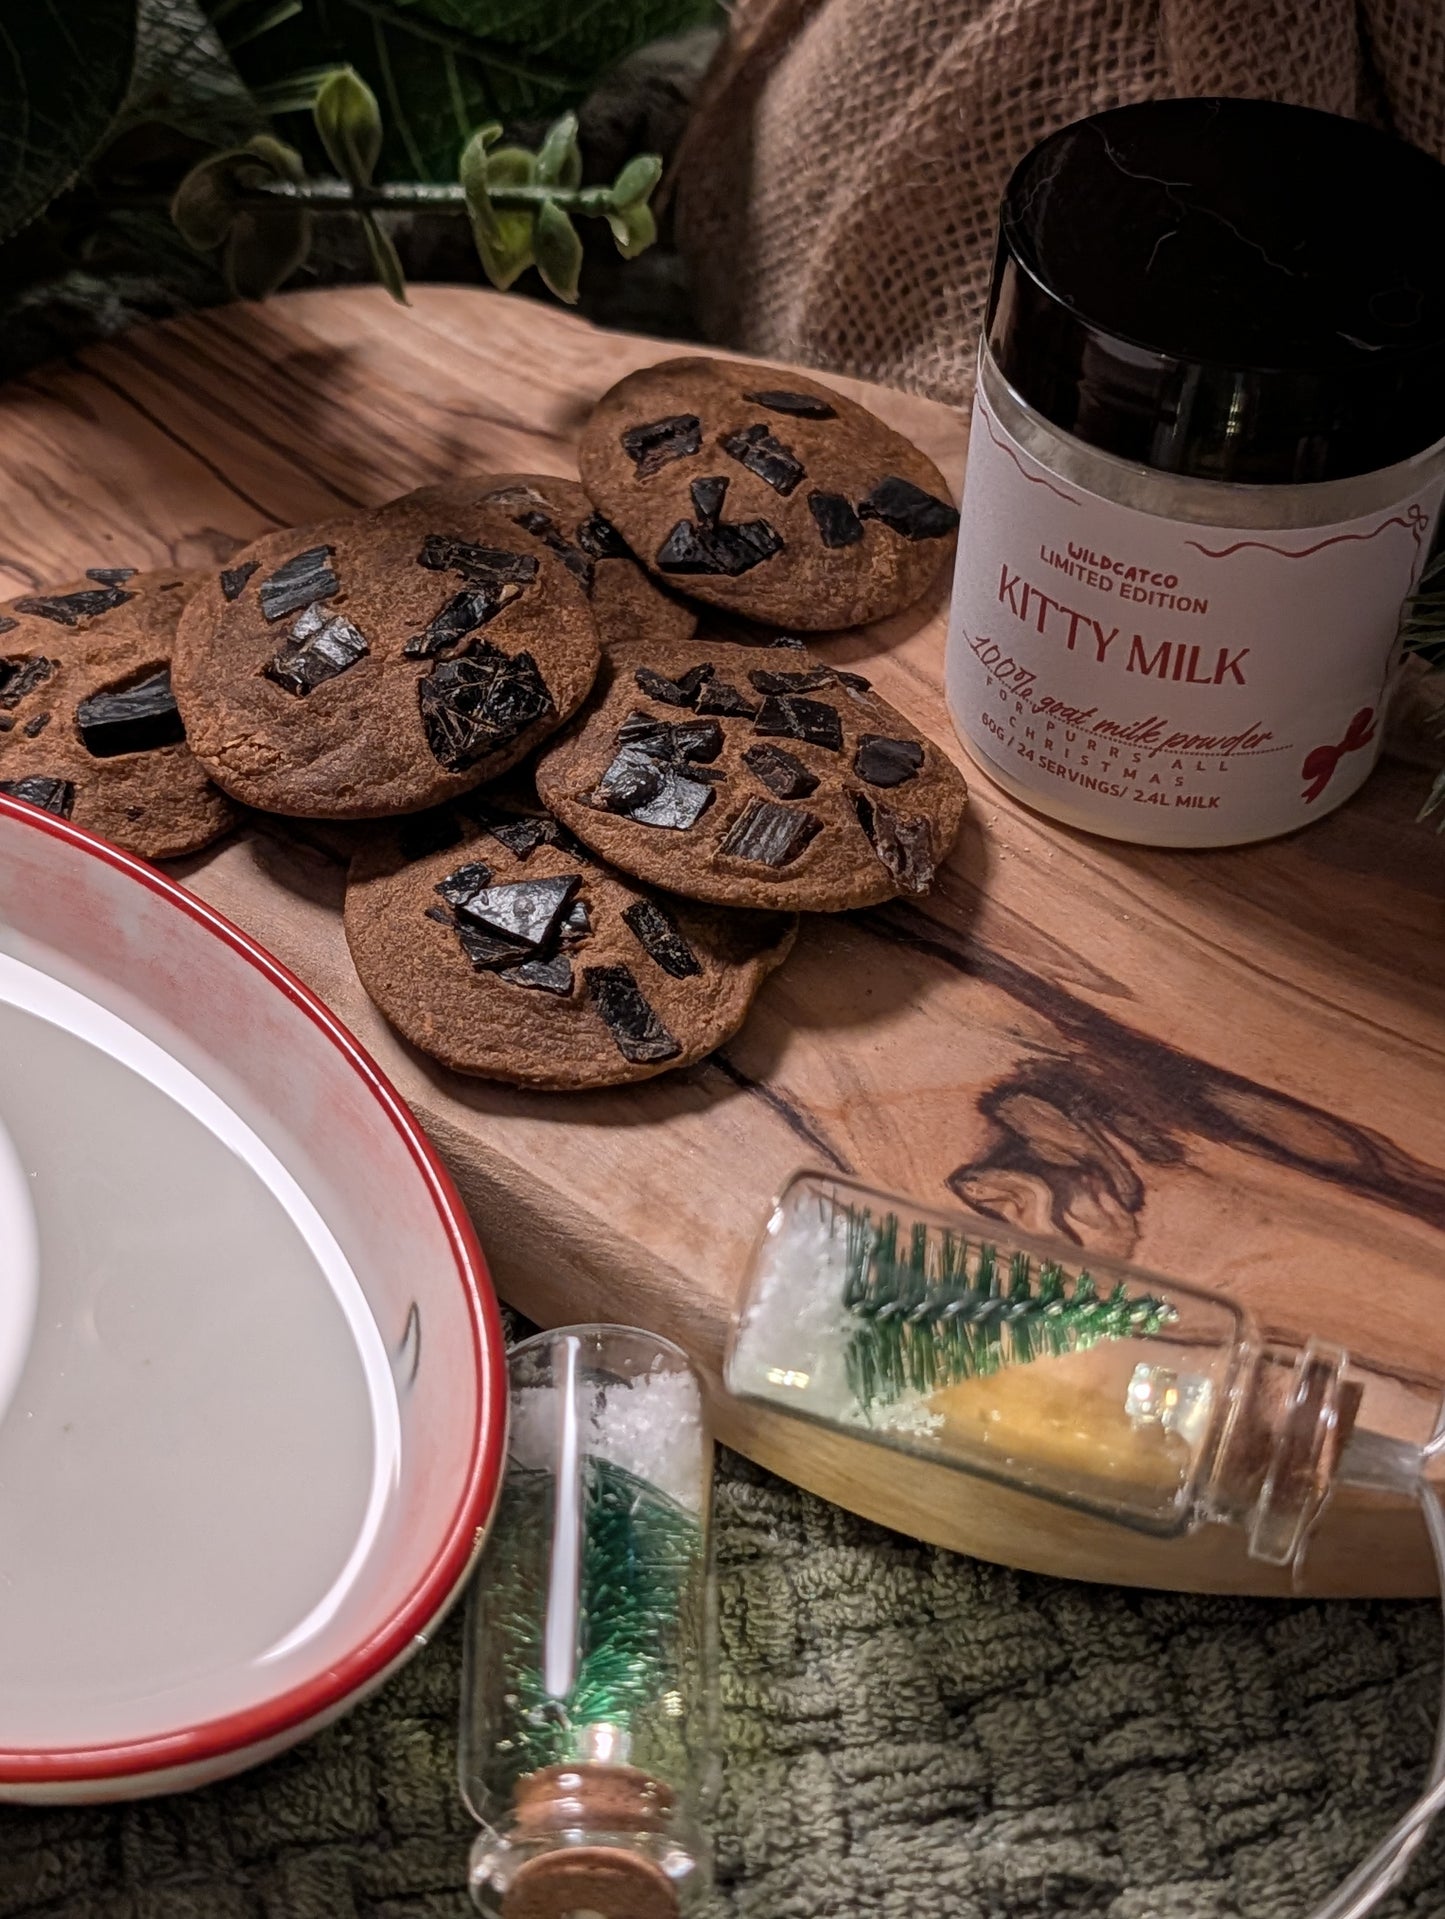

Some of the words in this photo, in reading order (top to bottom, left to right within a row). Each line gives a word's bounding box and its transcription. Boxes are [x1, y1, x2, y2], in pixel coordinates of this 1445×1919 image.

[1040, 544, 1114, 592] LIMITED
[1119, 582, 1209, 615] EDITION
[1067, 541, 1179, 589] WILDCATCO
[998, 563, 1120, 663] KITTY
[1126, 634, 1251, 686] MILK
[971, 635, 1037, 701] 100%
[1031, 696, 1099, 725] goat
[1092, 715, 1169, 744] milk
[1147, 720, 1274, 759] powder
[981, 711, 1005, 742] 60G
[1017, 742, 1035, 762] 24
[1175, 794, 1221, 809] MILK
